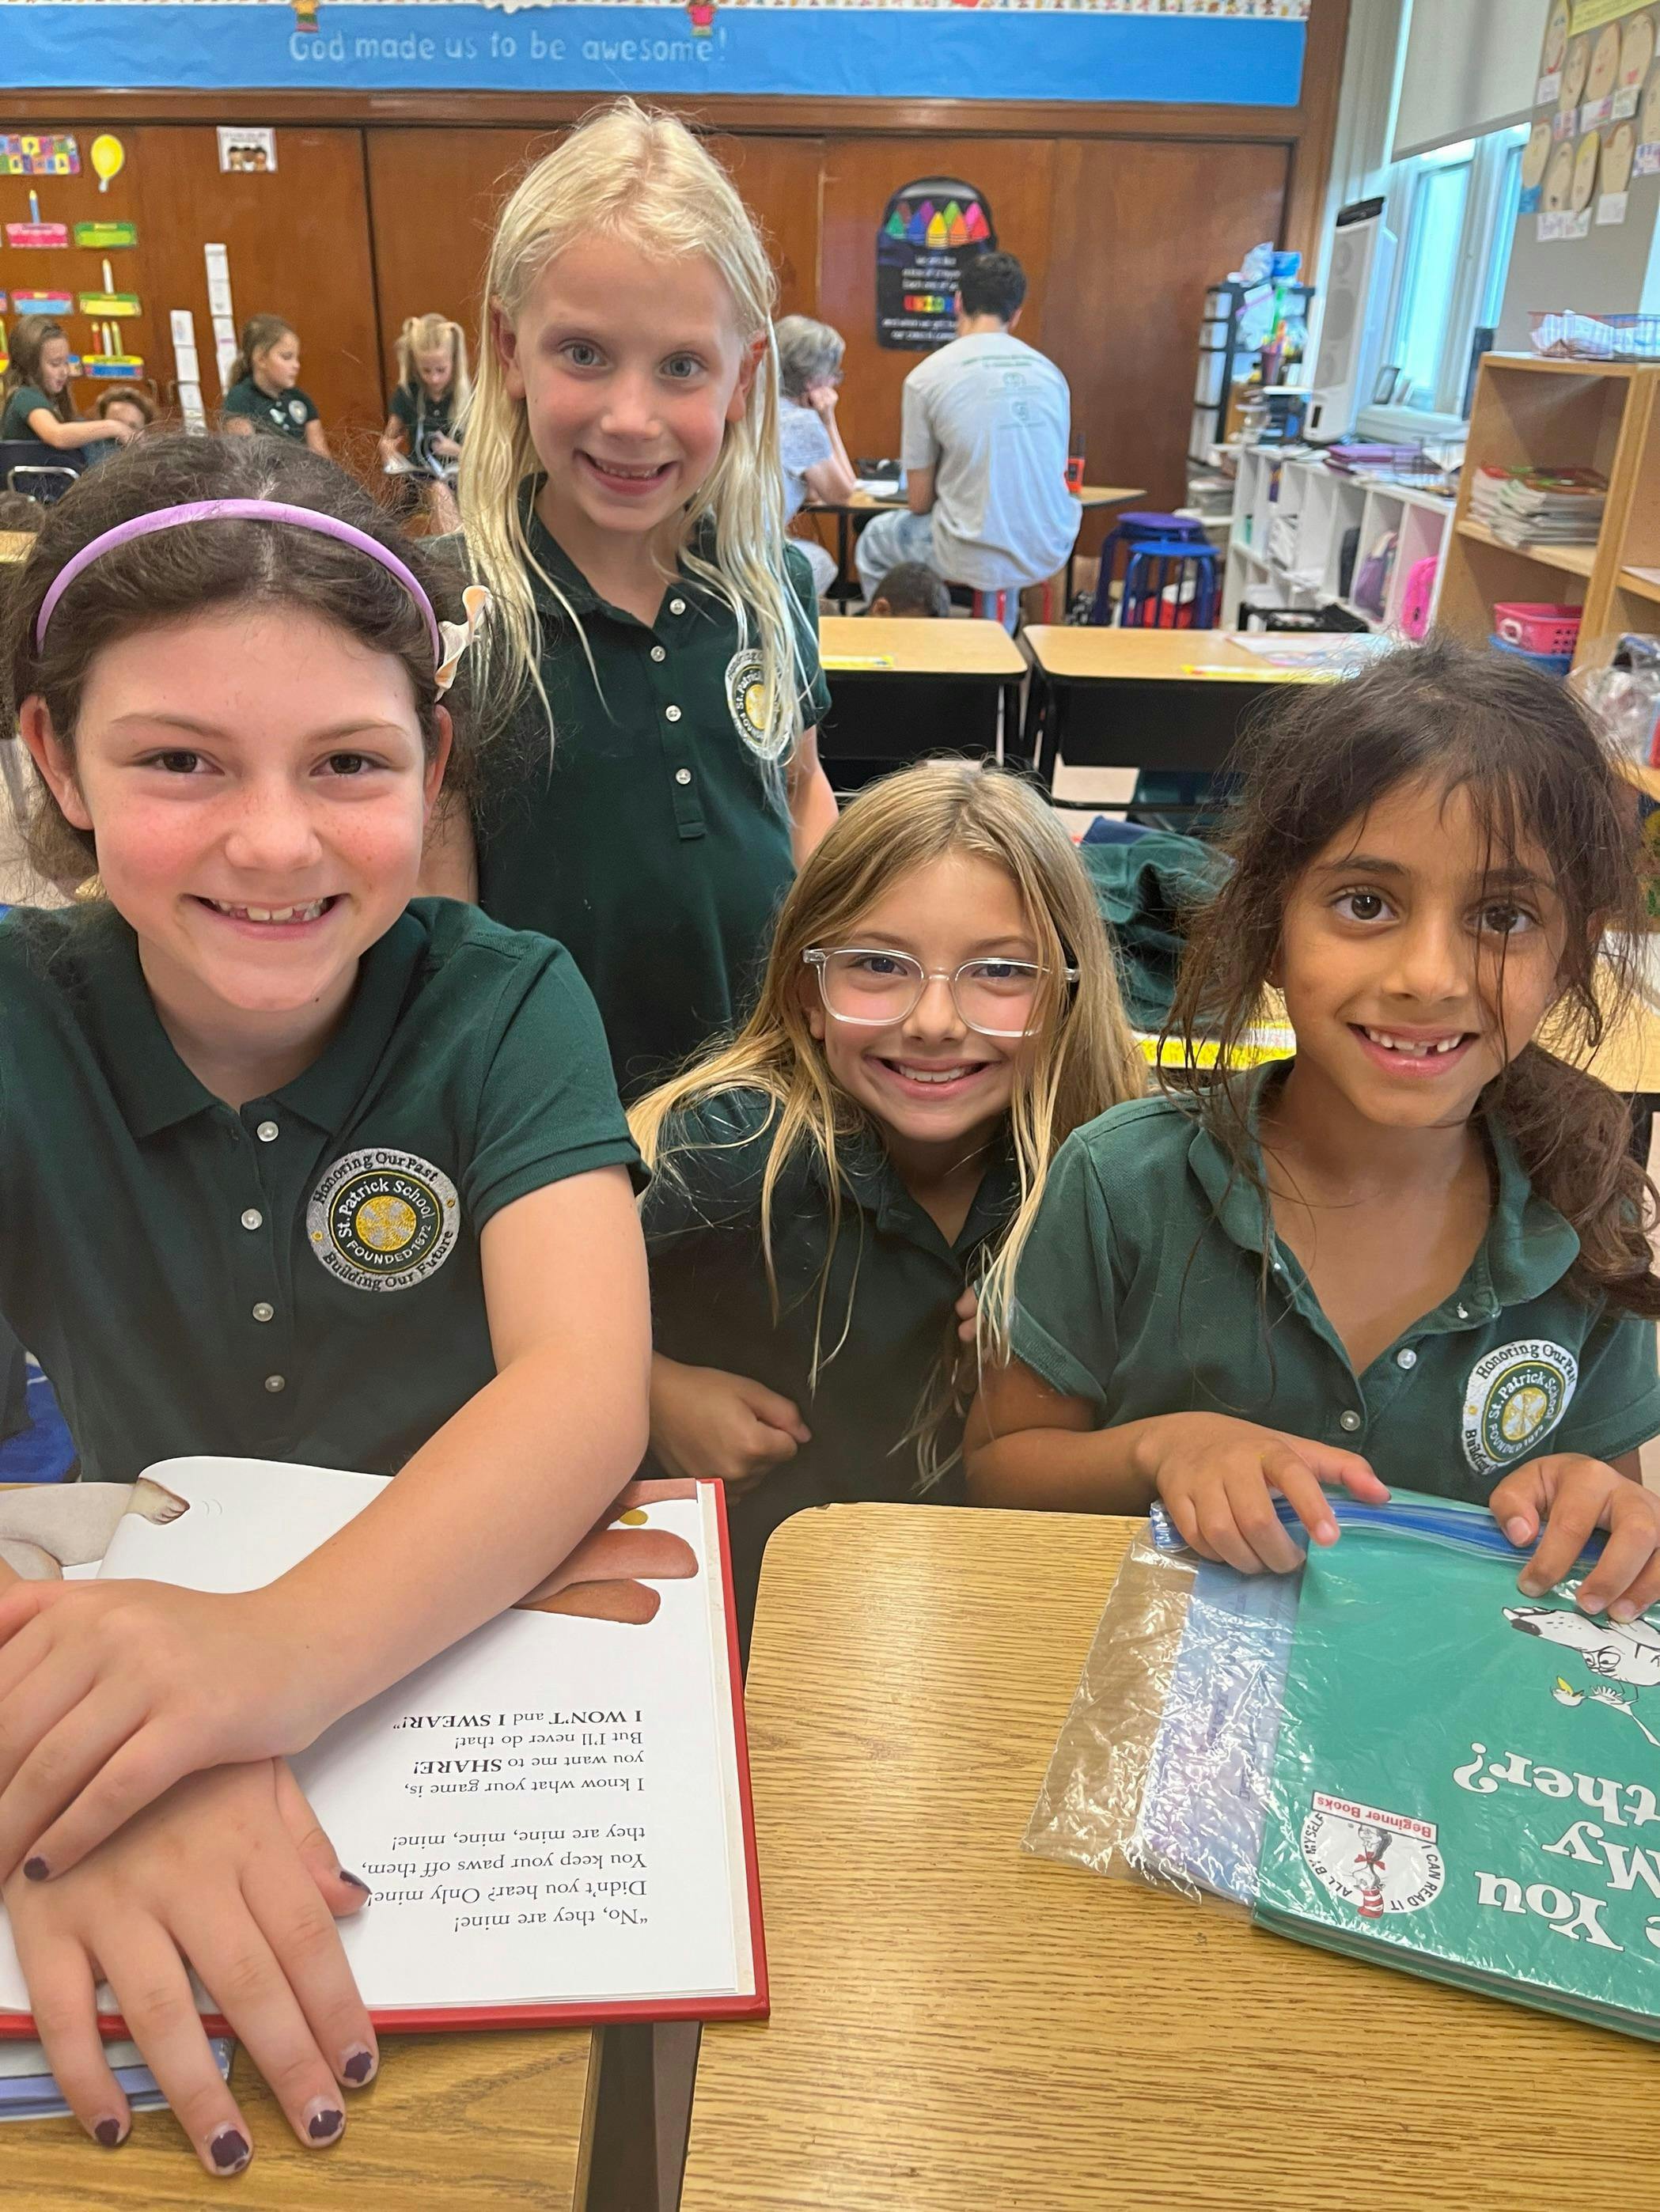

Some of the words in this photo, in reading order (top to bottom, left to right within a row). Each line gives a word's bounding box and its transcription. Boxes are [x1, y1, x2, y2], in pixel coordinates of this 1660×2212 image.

[290, 30, 345, 61] God
[355, 31, 436, 60] made
[444, 36, 477, 59] us
[491, 32, 517, 59] to
[530, 29, 567, 60] be
[582, 26, 727, 62] awesome!
[313, 1154, 373, 1204] Honoring
[376, 1152, 405, 1165] Our
[405, 1158, 439, 1182] Past
[339, 1177, 390, 1216] Patrick
[392, 1180, 435, 1219] School
[337, 1214, 352, 1238] St.
[346, 1240, 413, 1264] FOUNDED
[323, 1252, 382, 1292] Building
[385, 1271, 414, 1288] Our
[415, 1230, 453, 1275] Future
[1476, 1344, 1540, 1380] Honoring
[1489, 1400, 1505, 1419] St.
[1498, 1369, 1545, 1399] Patrick
[498, 1714, 506, 1726] I
[513, 1712, 544, 1726] and
[548, 1710, 627, 1725] WON’T
[635, 1710, 642, 1722] I
[455, 1736, 495, 1750] that!
[501, 1735, 523, 1748] do
[528, 1733, 575, 1744] never
[582, 1733, 606, 1746] I’ll
[612, 1732, 642, 1744] But
[507, 1757, 525, 1768] to
[531, 1757, 558, 1767] me
[563, 1756, 608, 1767] want
[613, 1750, 644, 1763] you
[413, 1759, 502, 1775] SHARE!
[404, 1783, 423, 1798] is,
[430, 1778, 480, 1793] game
[483, 1777, 526, 1792] your
[531, 1780, 575, 1794] what
[580, 1778, 630, 1792] know
[636, 1778, 646, 1791] I
[1317, 1796, 1361, 1819] Books
[572, 1828, 600, 1839] are
[605, 1824, 646, 1842] they
[1305, 1812, 1324, 1854] MYSELF
[1366, 1811, 1432, 1839] Beginner
[392, 1835, 446, 1851] mine!
[453, 1831, 506, 1847] mine,
[513, 1829, 565, 1844] mine,
[457, 1854, 506, 1871] paws
[510, 1851, 555, 1869] your
[559, 1850, 603, 1870] keep
[610, 1853, 647, 1869] You
[1426, 1854, 1441, 1880] CAN
[1541, 1820, 1660, 1899] My
[361, 1862, 416, 1879] them,
[419, 1862, 451, 1878] off
[487, 1884, 538, 1902] hear?
[545, 1877, 580, 1894] you
[585, 1880, 647, 1898] Didn’t
[1330, 1876, 1353, 1897] ALL
[1407, 1881, 1438, 1907] READ
[367, 1888, 424, 1907] mine!
[430, 1884, 480, 1905] Only
[1390, 1900, 1405, 1911] IT
[1474, 1871, 1624, 1952] You
[454, 1915, 510, 1933] mine!
[517, 1912, 547, 1924] are
[552, 1906, 595, 1927] they
